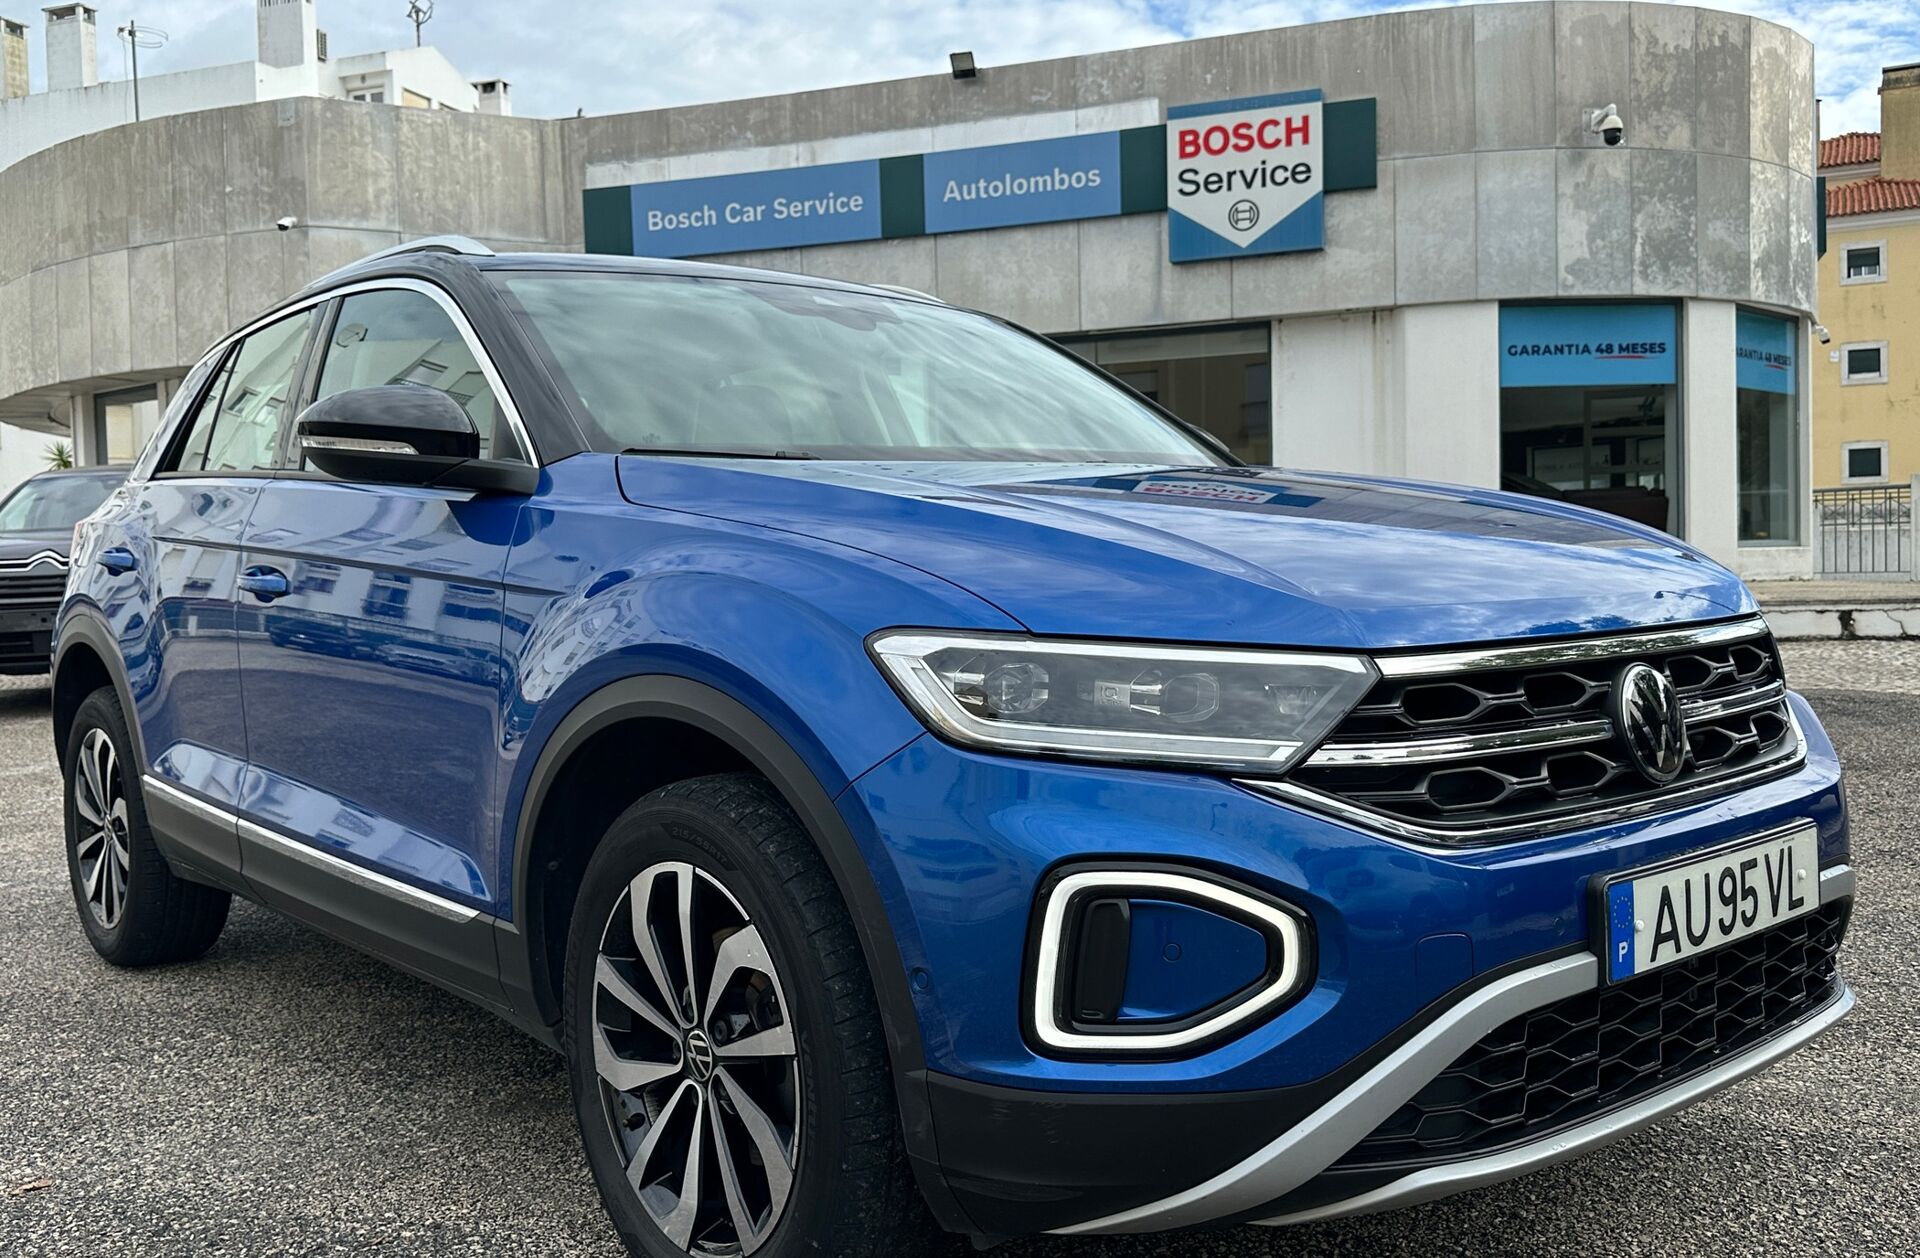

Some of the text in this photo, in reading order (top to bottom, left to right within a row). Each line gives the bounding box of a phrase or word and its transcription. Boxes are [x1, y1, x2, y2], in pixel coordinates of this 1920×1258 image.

[1178, 115, 1310, 160] BOSCH
[943, 167, 1101, 203] Autolombos
[1177, 160, 1312, 197] Service
[648, 192, 864, 231] Bosch Car Service
[1507, 341, 1667, 357] GARANTIA 48 MESES
[1764, 352, 1772, 363] 48
[1618, 941, 1629, 963] P
